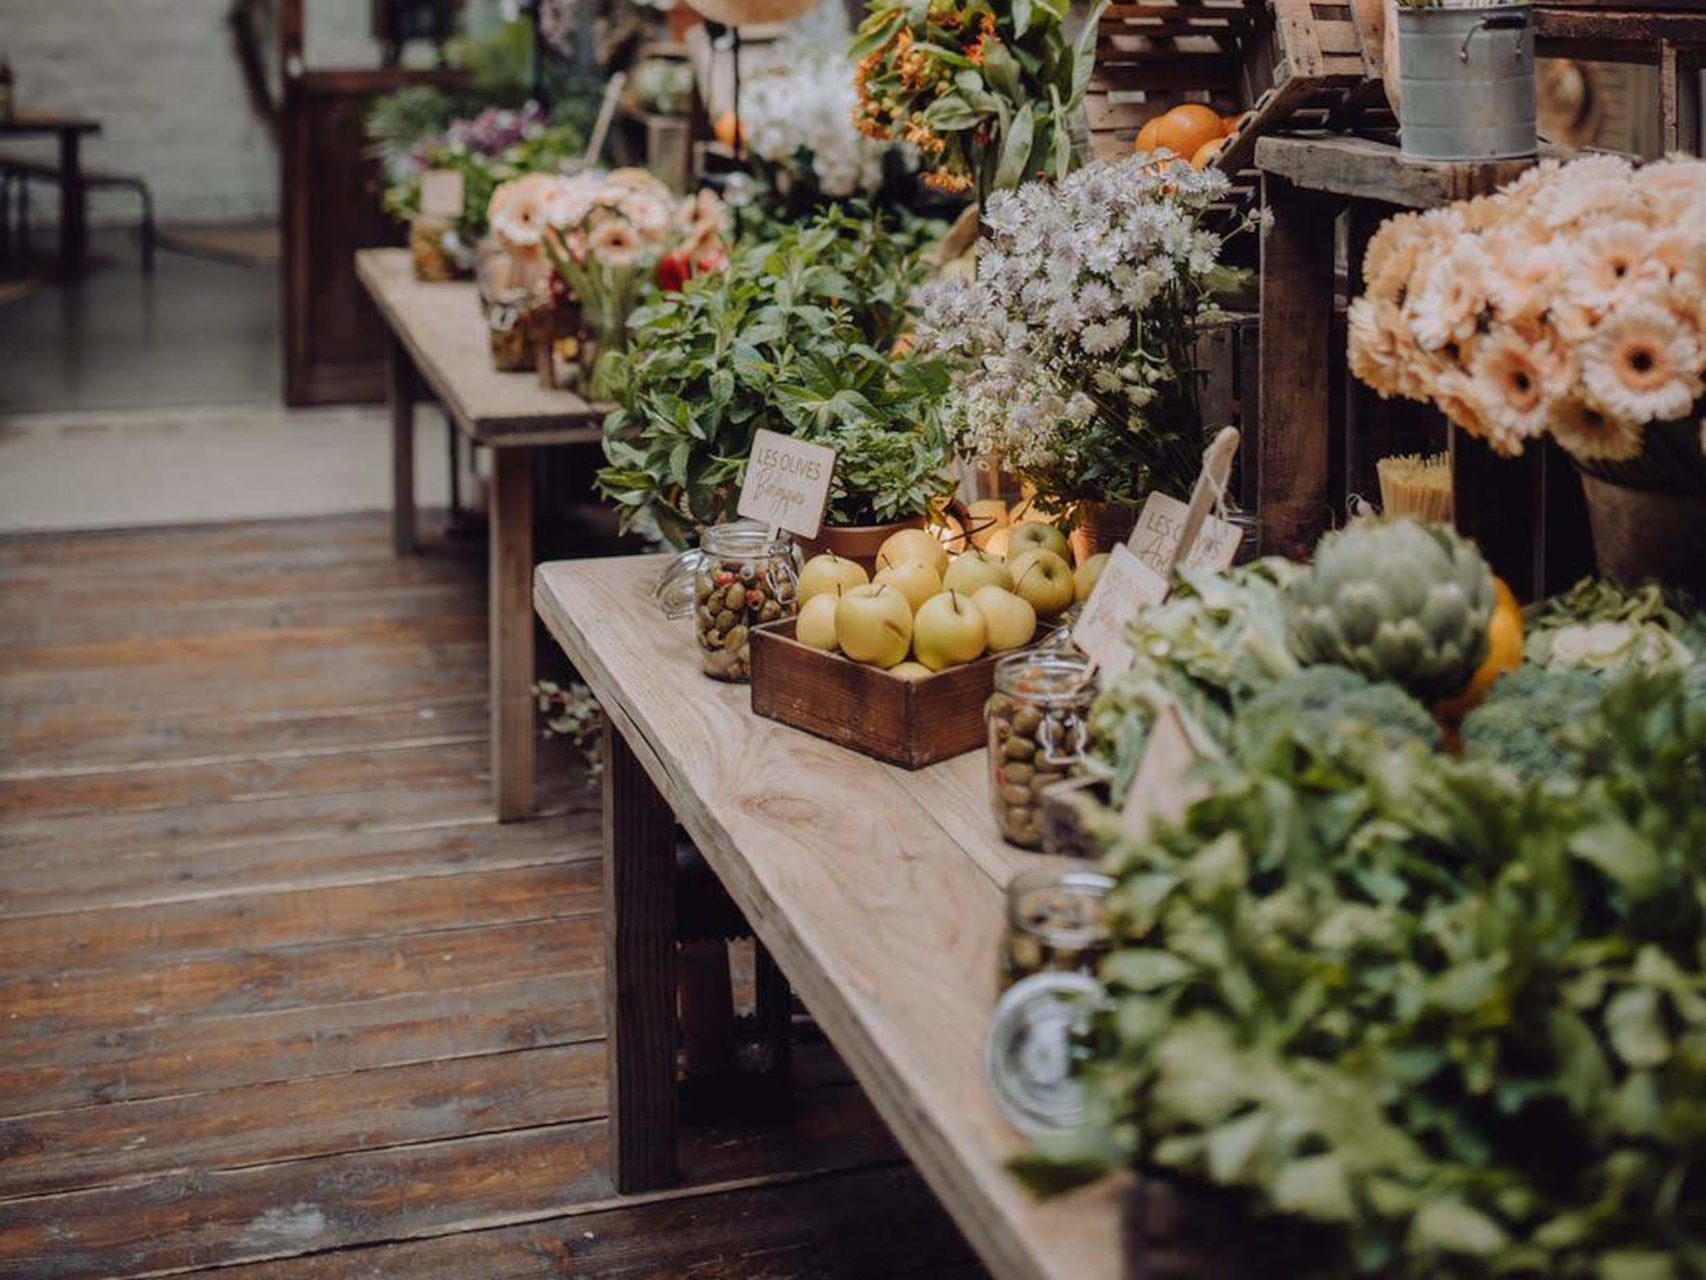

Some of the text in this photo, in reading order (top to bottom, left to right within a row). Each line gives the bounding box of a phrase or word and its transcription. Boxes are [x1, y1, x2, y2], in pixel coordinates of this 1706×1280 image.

[758, 448, 822, 481] LES OLIVES
[1146, 512, 1170, 537] LES
